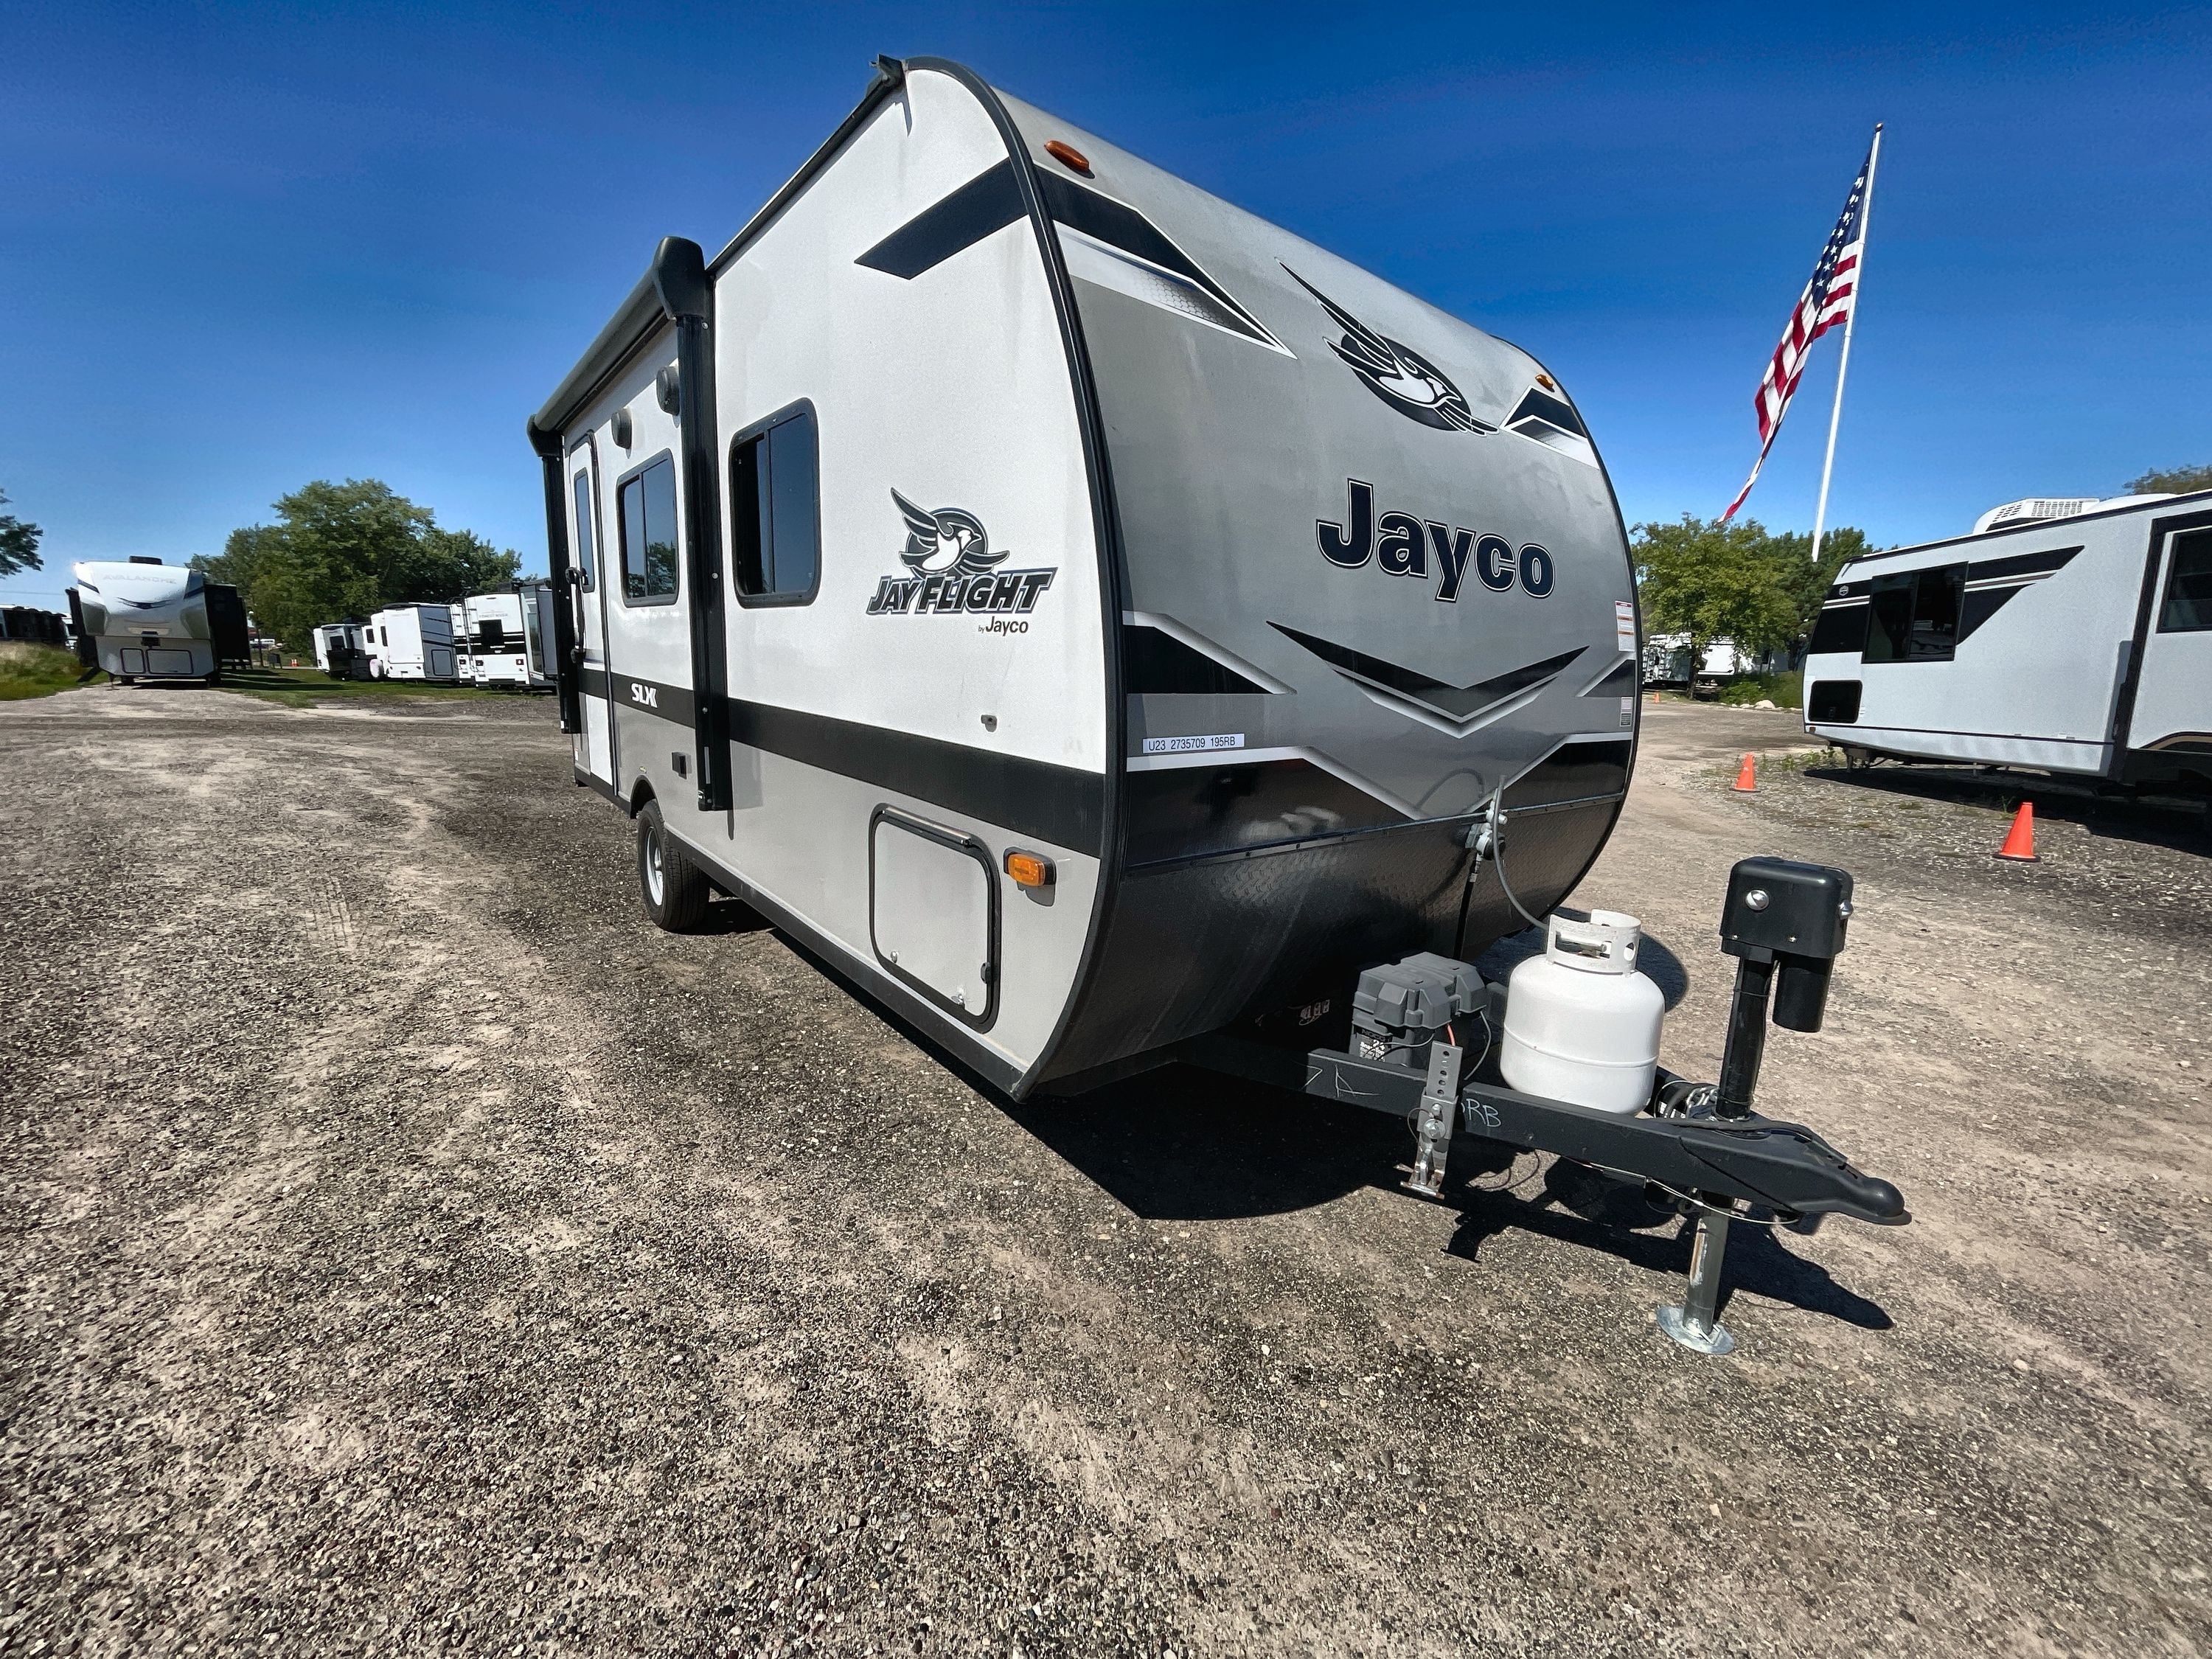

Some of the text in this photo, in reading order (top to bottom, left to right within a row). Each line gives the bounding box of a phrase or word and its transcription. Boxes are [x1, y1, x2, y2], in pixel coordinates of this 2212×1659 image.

[1316, 478, 1556, 603] Jayco
[103, 575, 177, 584] AVALANCHE
[978, 616, 1029, 636] by Jayco
[631, 683, 658, 708] SLX
[1149, 736, 1236, 751] U23 2735709 195RB
